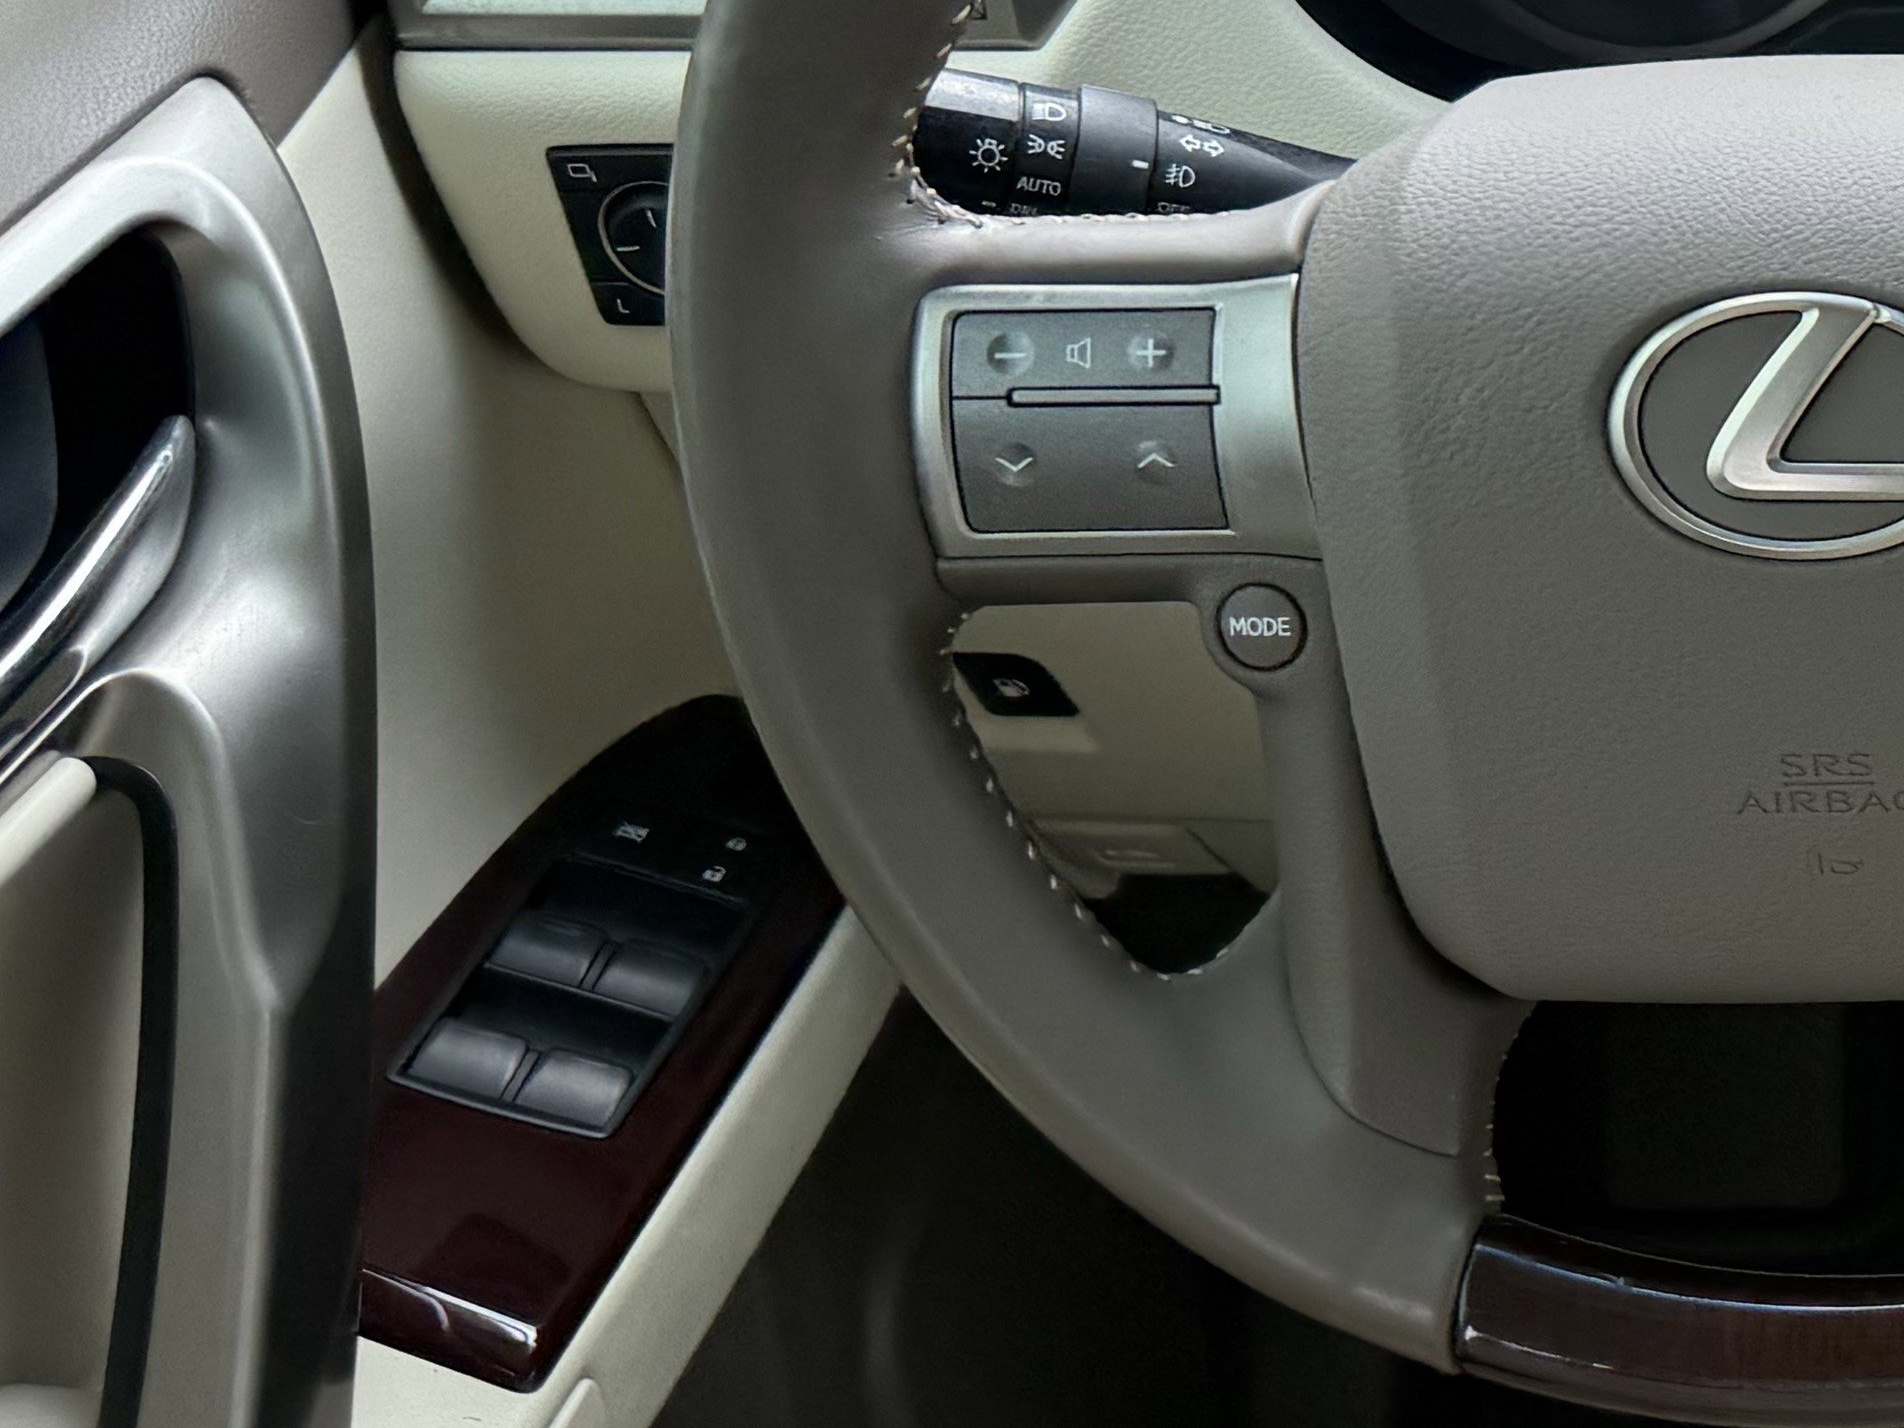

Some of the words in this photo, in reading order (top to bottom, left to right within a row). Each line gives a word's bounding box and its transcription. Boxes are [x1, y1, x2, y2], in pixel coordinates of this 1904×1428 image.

[1016, 175, 1062, 197] AUTO
[1228, 616, 1292, 637] MODE
[1780, 752, 1874, 778] SRS
